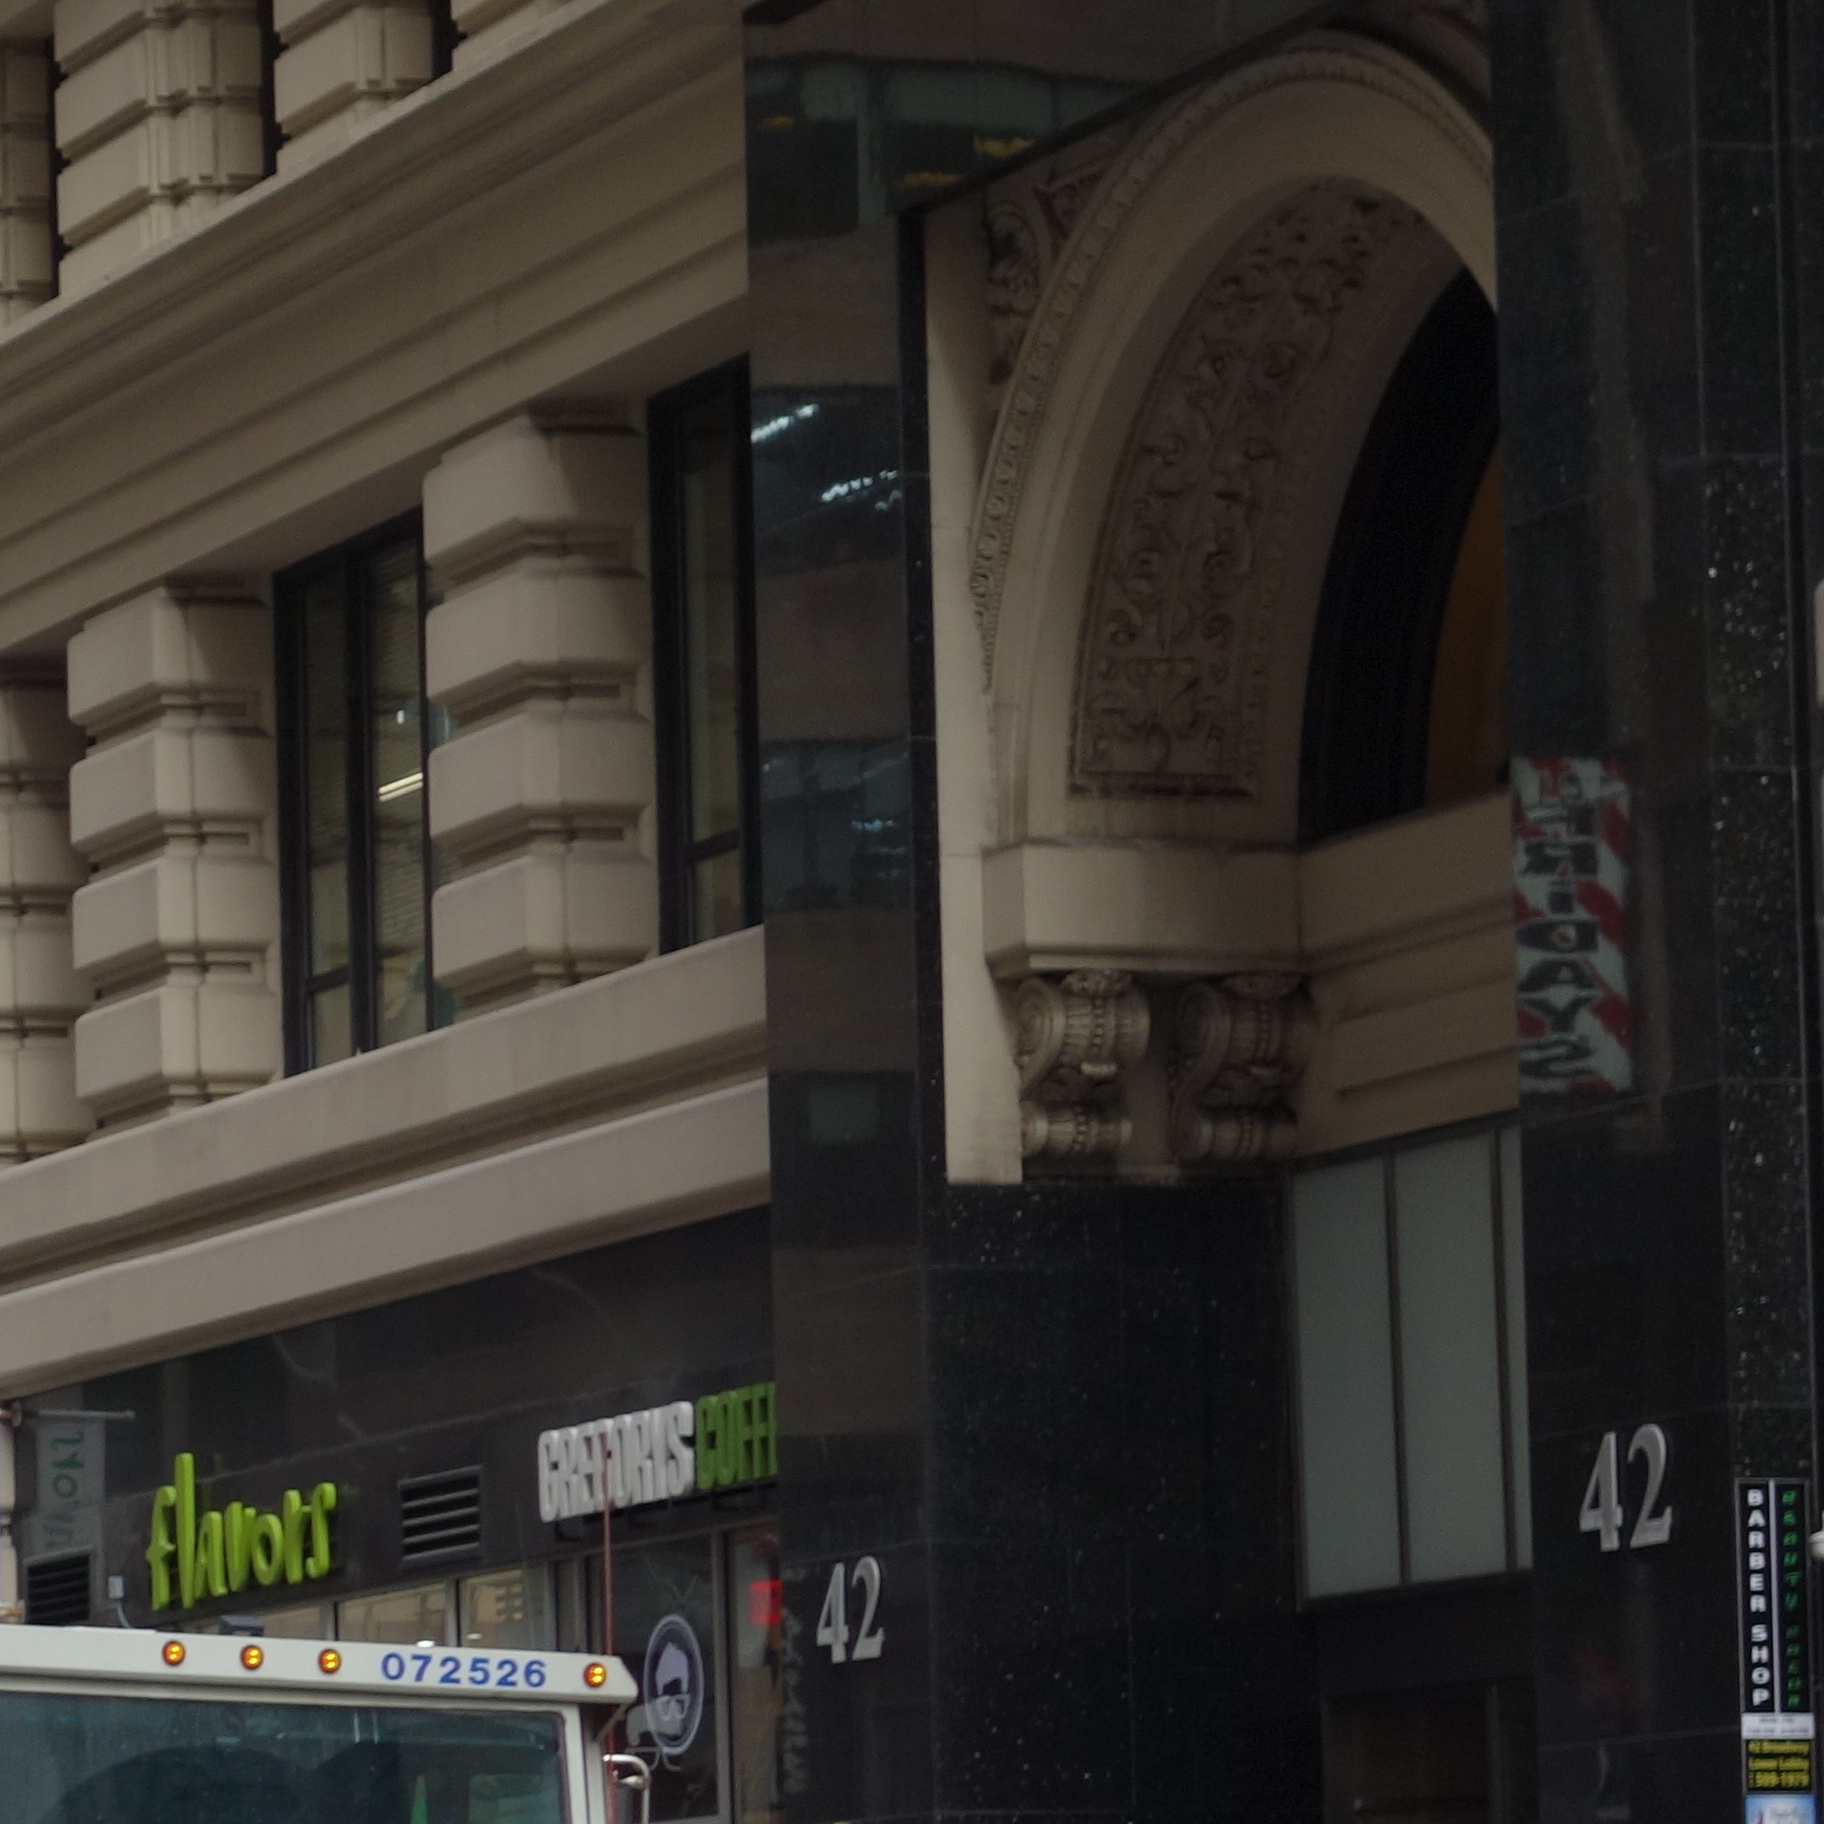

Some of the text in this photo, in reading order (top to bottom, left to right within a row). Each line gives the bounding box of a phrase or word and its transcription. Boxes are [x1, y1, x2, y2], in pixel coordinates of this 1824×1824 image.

[538, 1400, 696, 1523] GREGORYS
[1579, 1423, 1673, 1552] 42
[145, 1451, 339, 1612] flavors
[816, 1555, 885, 1664] 42
[1747, 1488, 1770, 1707] BARBER SHOP
[381, 1652, 547, 1688] 072526
